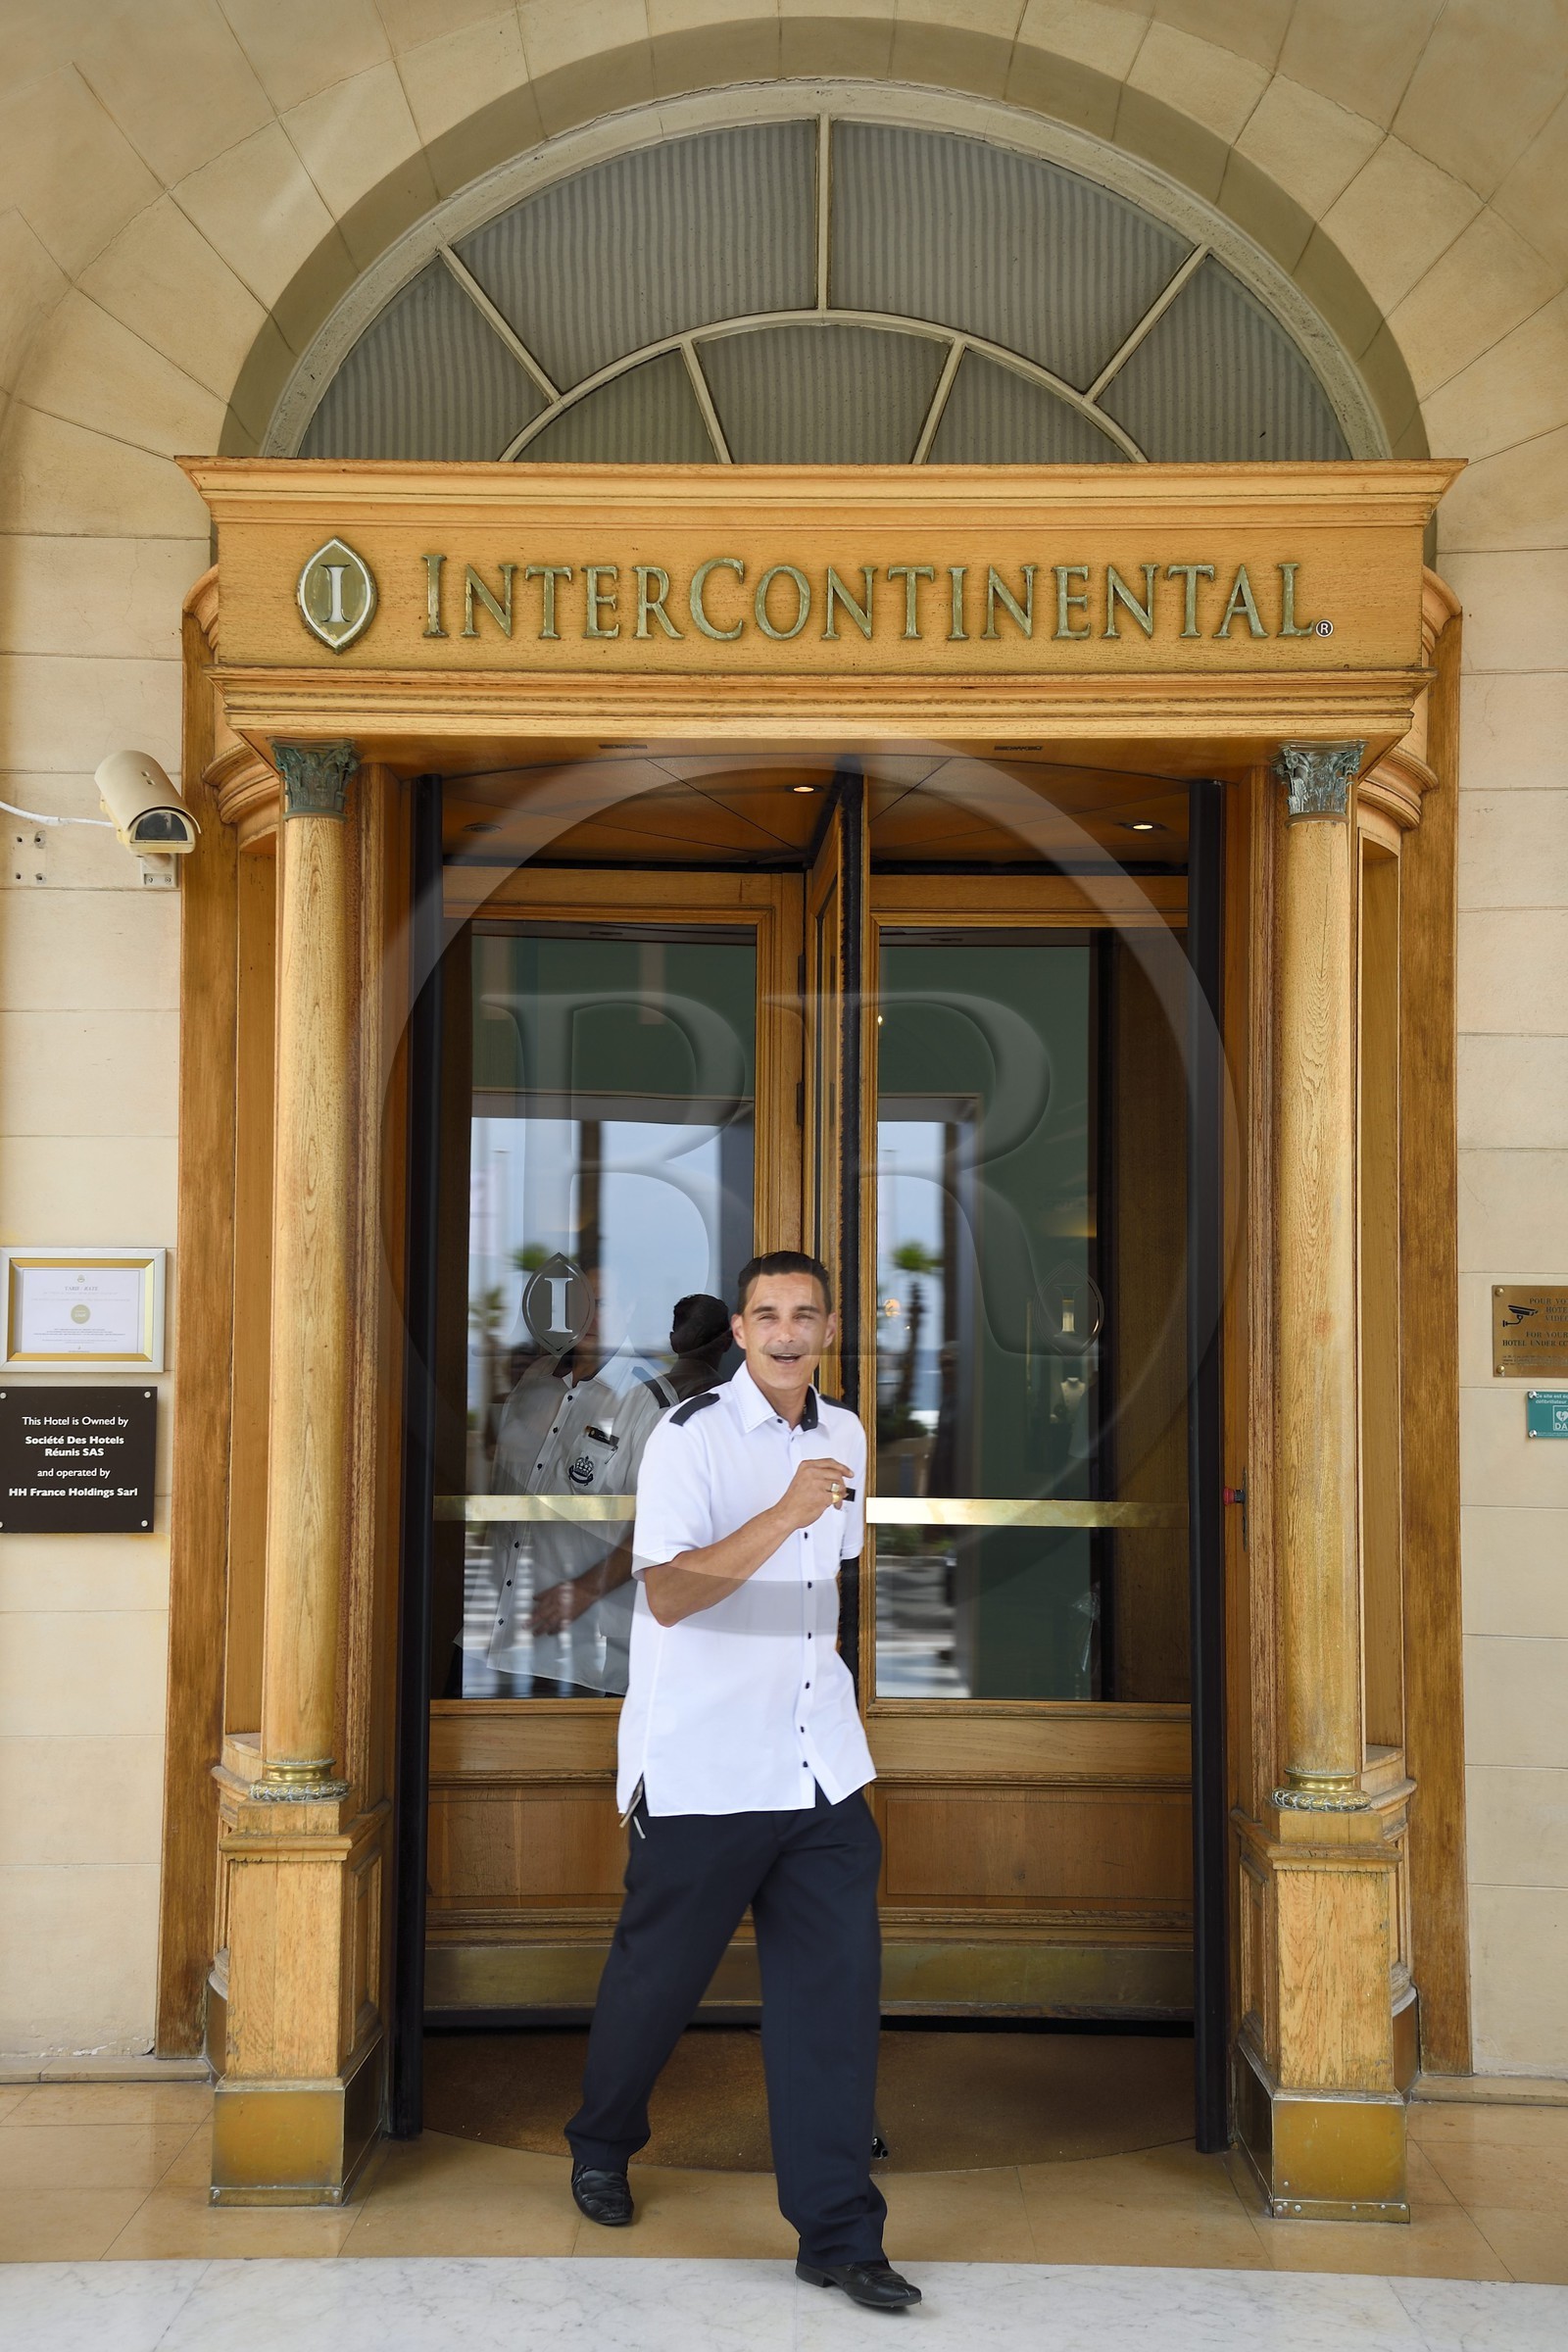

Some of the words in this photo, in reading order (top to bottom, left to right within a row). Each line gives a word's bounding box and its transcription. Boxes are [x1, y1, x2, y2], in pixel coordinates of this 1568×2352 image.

[22, 1416, 41, 1426] This
[43, 1416, 70, 1426] Hotel
[72, 1416, 79, 1426] is
[81, 1416, 116, 1426] Owned
[118, 1416, 129, 1428] by
[24, 1436, 65, 1445] Société
[67, 1436, 87, 1445] Des
[89, 1436, 124, 1445] Hotels
[44, 1447, 80, 1457] Réunis
[82, 1447, 105, 1457] SAS
[36, 1468, 54, 1477] and
[56, 1468, 97, 1479] operated
[99, 1468, 111, 1479] by
[8, 1488, 27, 1496] HH
[29, 1488, 66, 1496] France
[68, 1488, 115, 1498] Holdings
[117, 1488, 138, 1496] Sarl
